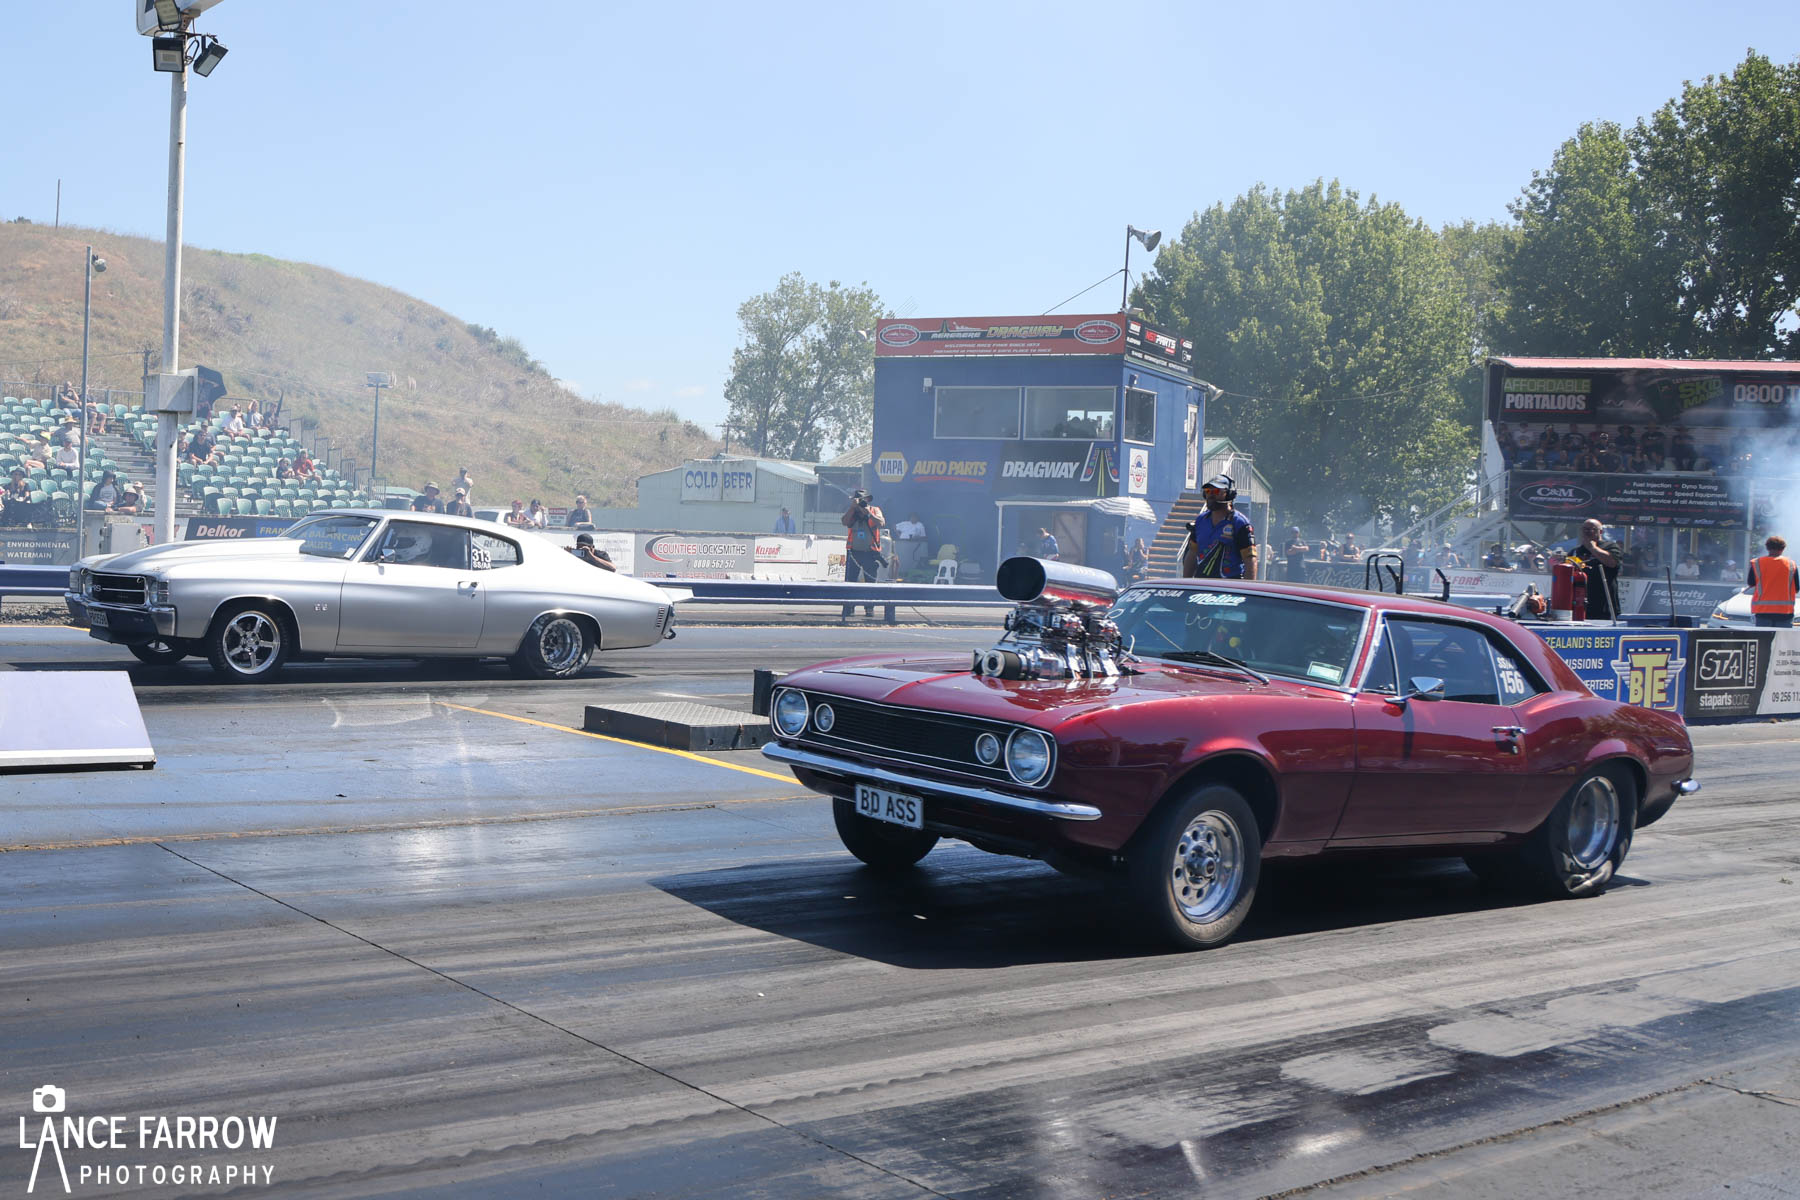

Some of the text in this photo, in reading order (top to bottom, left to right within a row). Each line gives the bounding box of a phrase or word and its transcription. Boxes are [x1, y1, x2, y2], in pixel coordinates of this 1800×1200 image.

[987, 325, 1063, 338] DRAGWAY
[1504, 379, 1591, 392] AFFORDABLE
[1734, 384, 1784, 403] 0800
[1505, 393, 1586, 410] PORTALOOS
[880, 460, 987, 476] NAPA AUTO PARTS
[1002, 461, 1080, 478] DRAGWAY
[685, 470, 753, 489] COLD BEER
[1537, 487, 1576, 497] C&M
[196, 524, 246, 538] Delkor
[7, 541, 70, 549] ENVIRONMENTAL
[657, 543, 746, 556] COUNTIES LOCKSMITHS
[7, 551, 52, 559] WATERMAIN
[472, 548, 491, 563] 313
[711, 559, 723, 569] 562
[1123, 588, 1246, 605] 156 SS/AA Motive
[1652, 589, 1707, 600] security
[1545, 637, 1616, 648] ZEALAND'S BEST
[1700, 644, 1756, 684] STA PARTS
[1500, 670, 1525, 694] 156
[1772, 692, 1780, 703] 09
[861, 788, 916, 823] BD ASS
